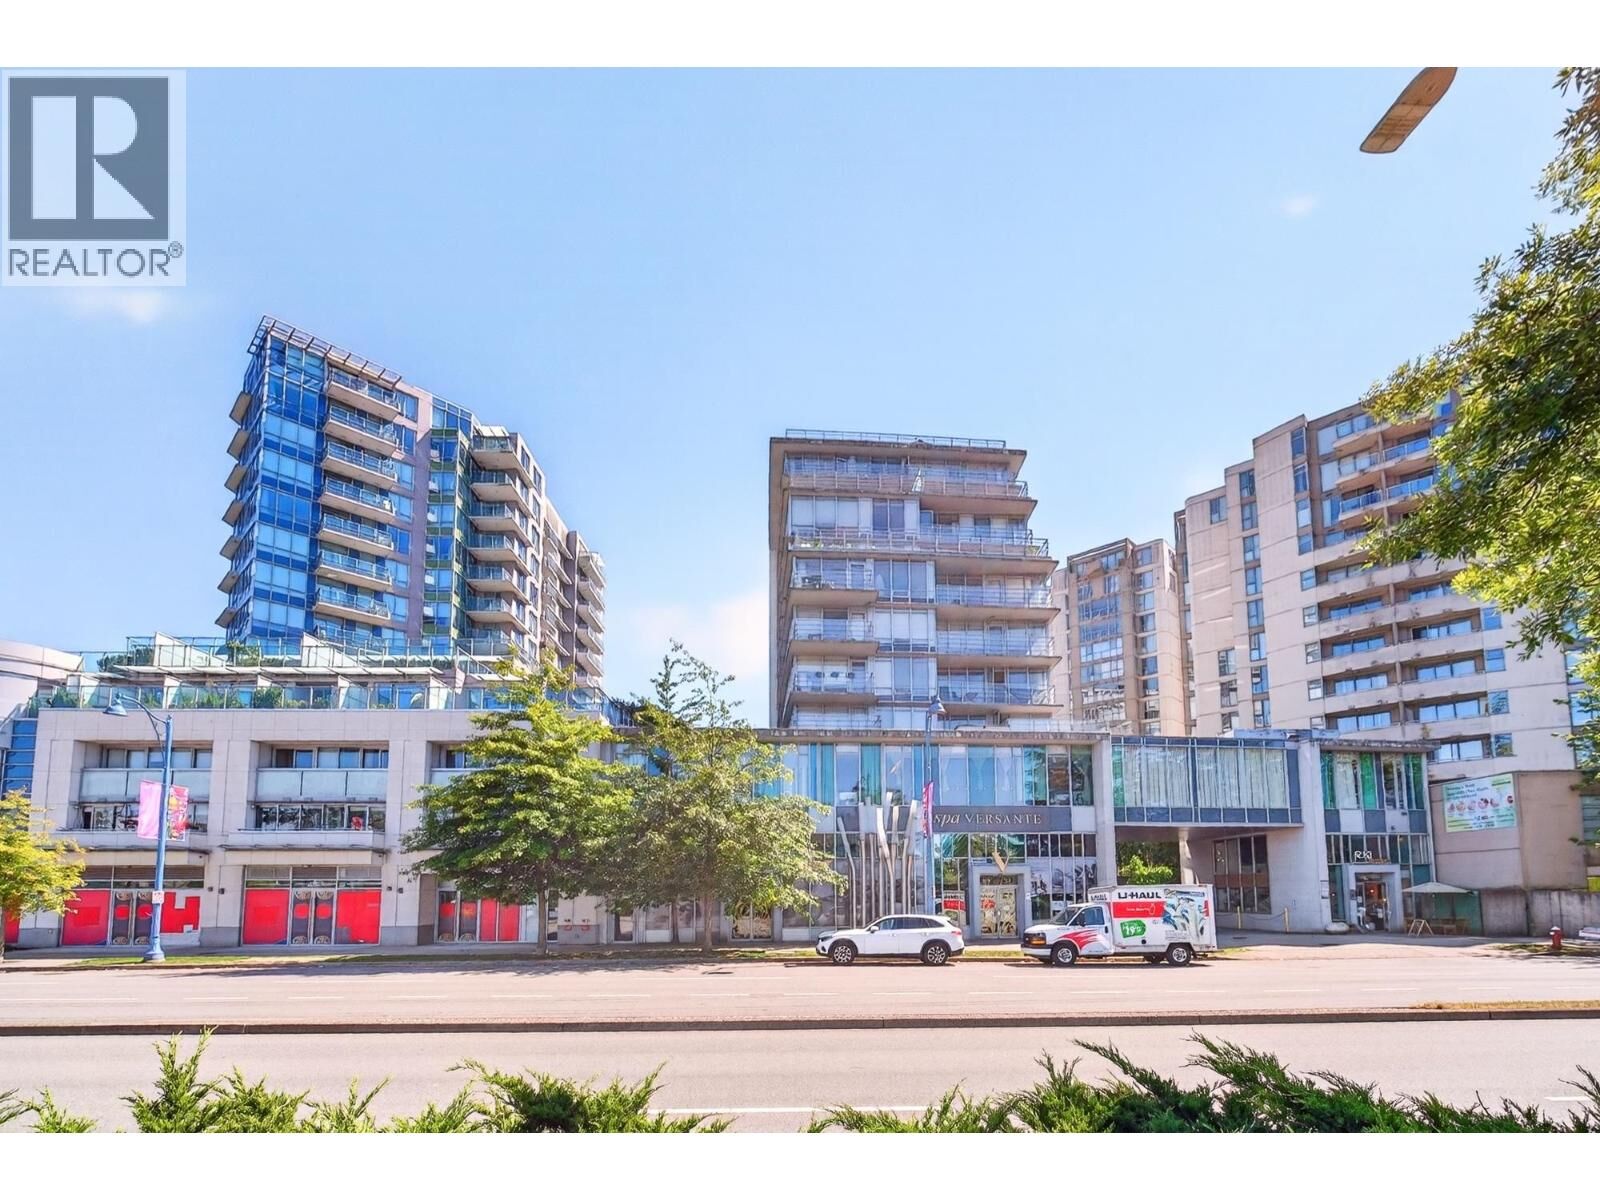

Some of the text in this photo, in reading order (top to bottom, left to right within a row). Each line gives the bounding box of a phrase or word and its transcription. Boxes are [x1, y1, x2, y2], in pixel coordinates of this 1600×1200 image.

[933, 814, 1042, 827] spa VERSANTE
[1118, 891, 1162, 899] U-HAUL
